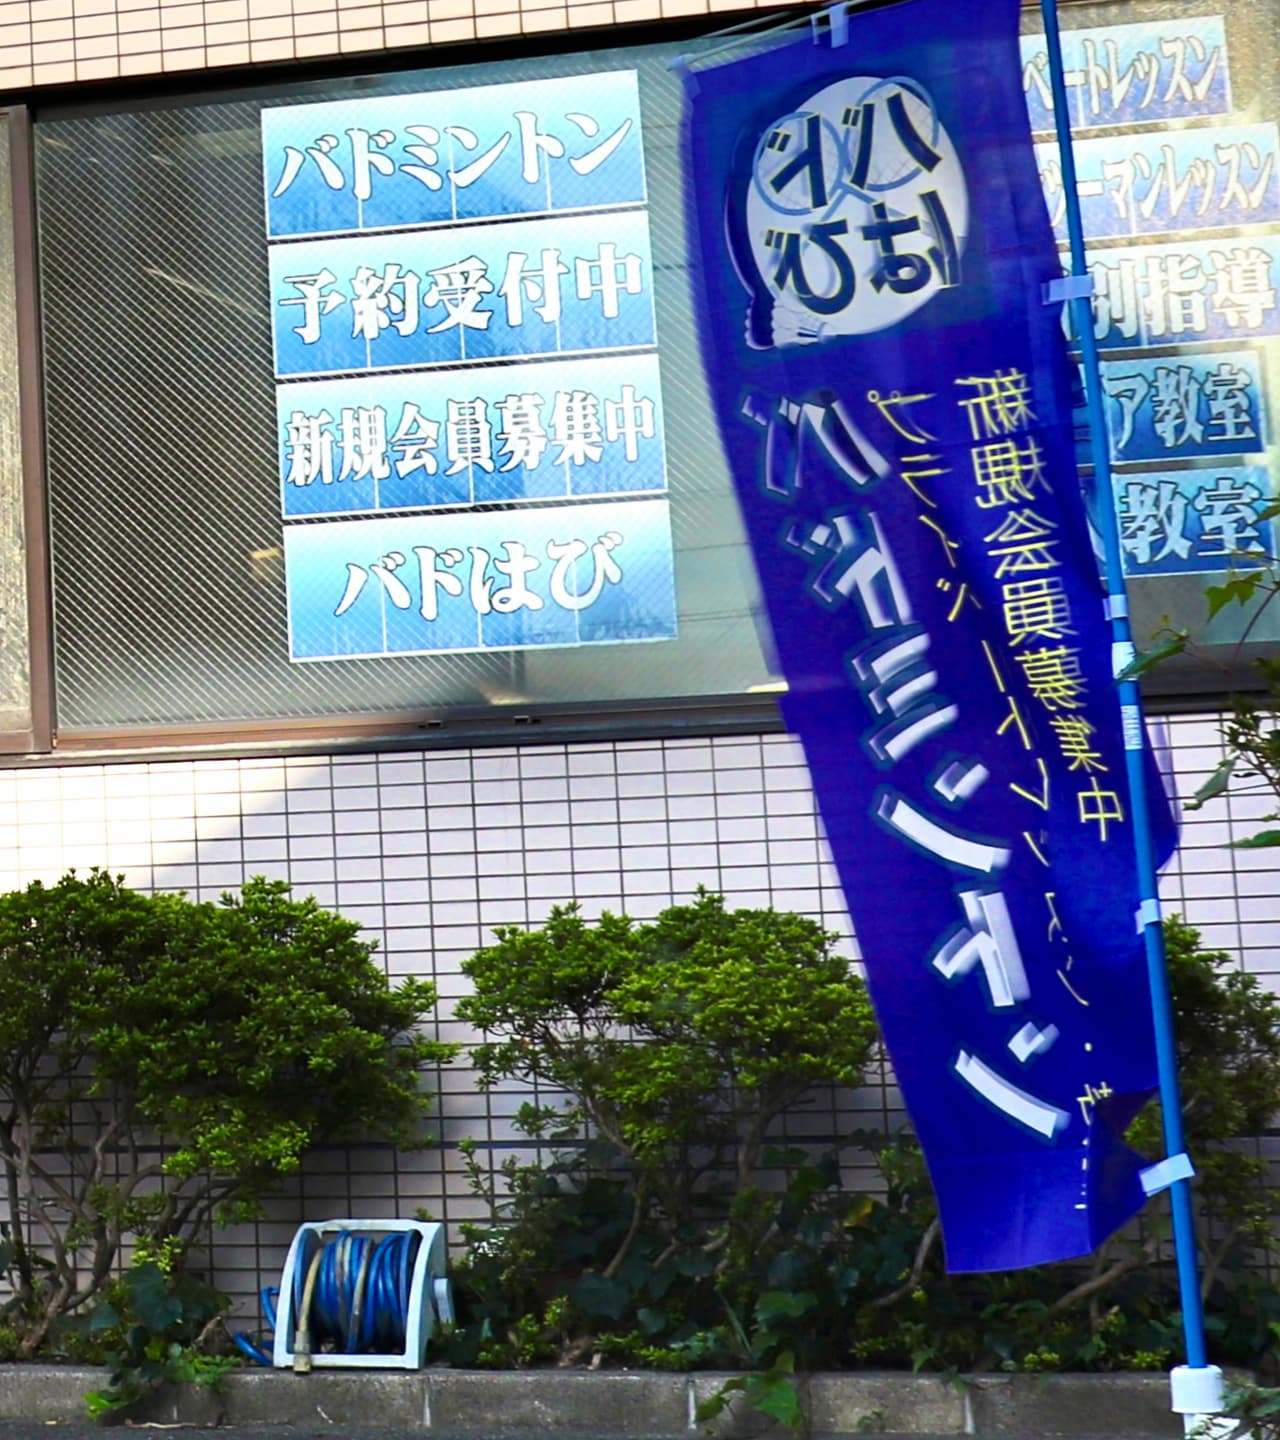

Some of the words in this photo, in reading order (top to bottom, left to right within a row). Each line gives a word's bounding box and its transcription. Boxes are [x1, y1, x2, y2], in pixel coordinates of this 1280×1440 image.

[272, 110, 633, 201] バドミントン
[278, 242, 643, 345] 予約受付中
[1060, 247, 1276, 341] 別指導
[285, 384, 656, 488] 新規会員募集中
[1082, 363, 1257, 449] ア教室
[1082, 477, 1268, 565] 教室
[333, 530, 624, 622] バドはび
